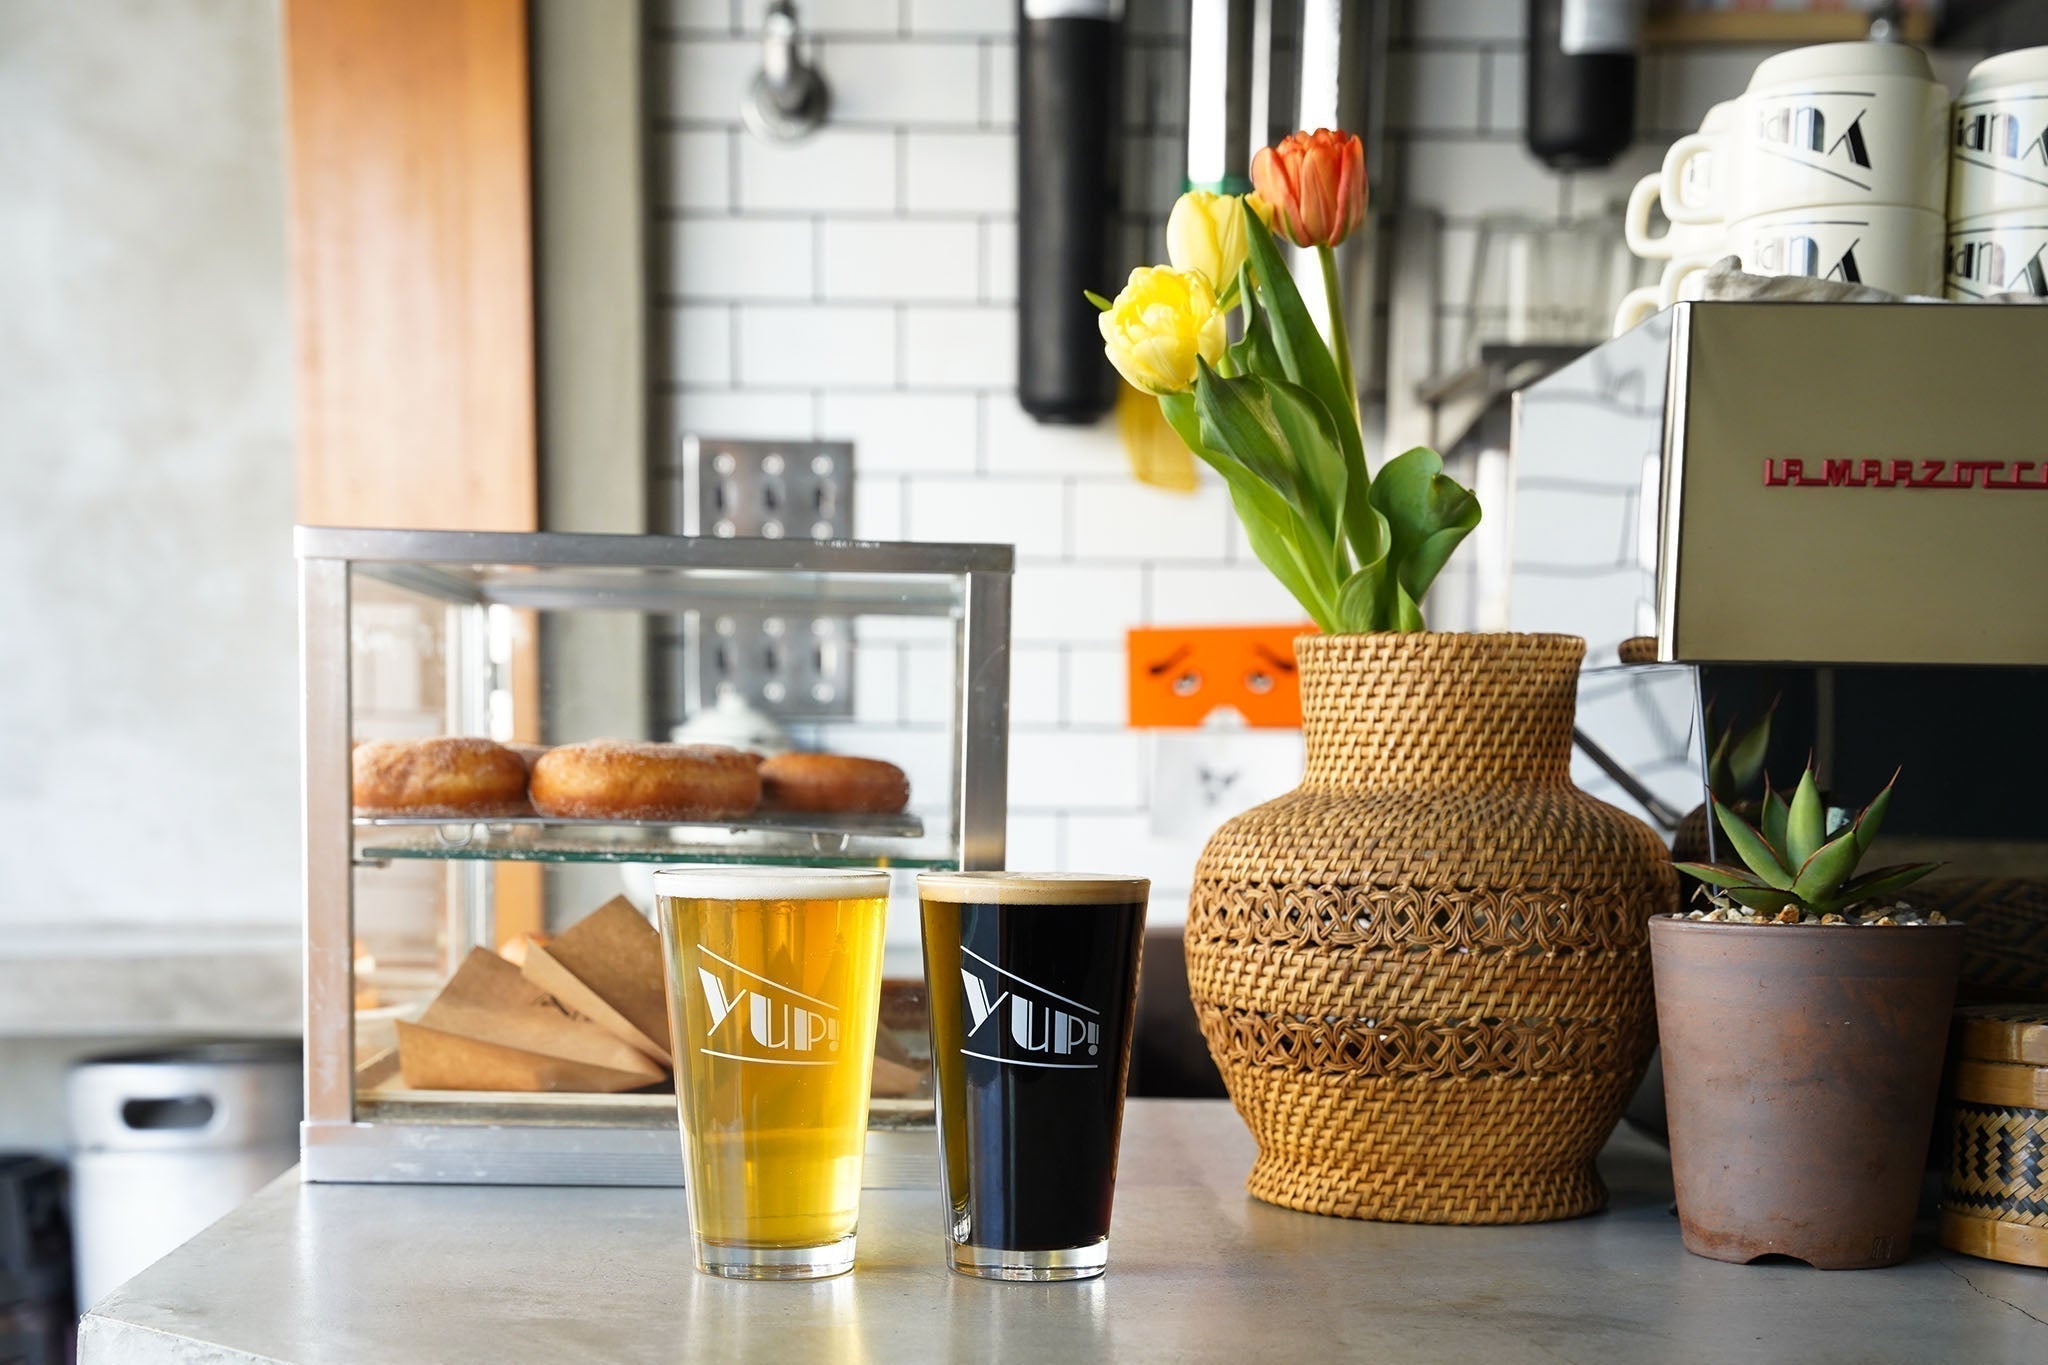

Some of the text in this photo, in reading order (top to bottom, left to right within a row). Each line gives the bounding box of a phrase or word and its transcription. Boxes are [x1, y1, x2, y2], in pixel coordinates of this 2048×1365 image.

[1758, 106, 1872, 169] YUP!
[1763, 457, 1803, 487] LA
[697, 966, 840, 1051] YUP!
[960, 967, 1100, 1056] YUP!
